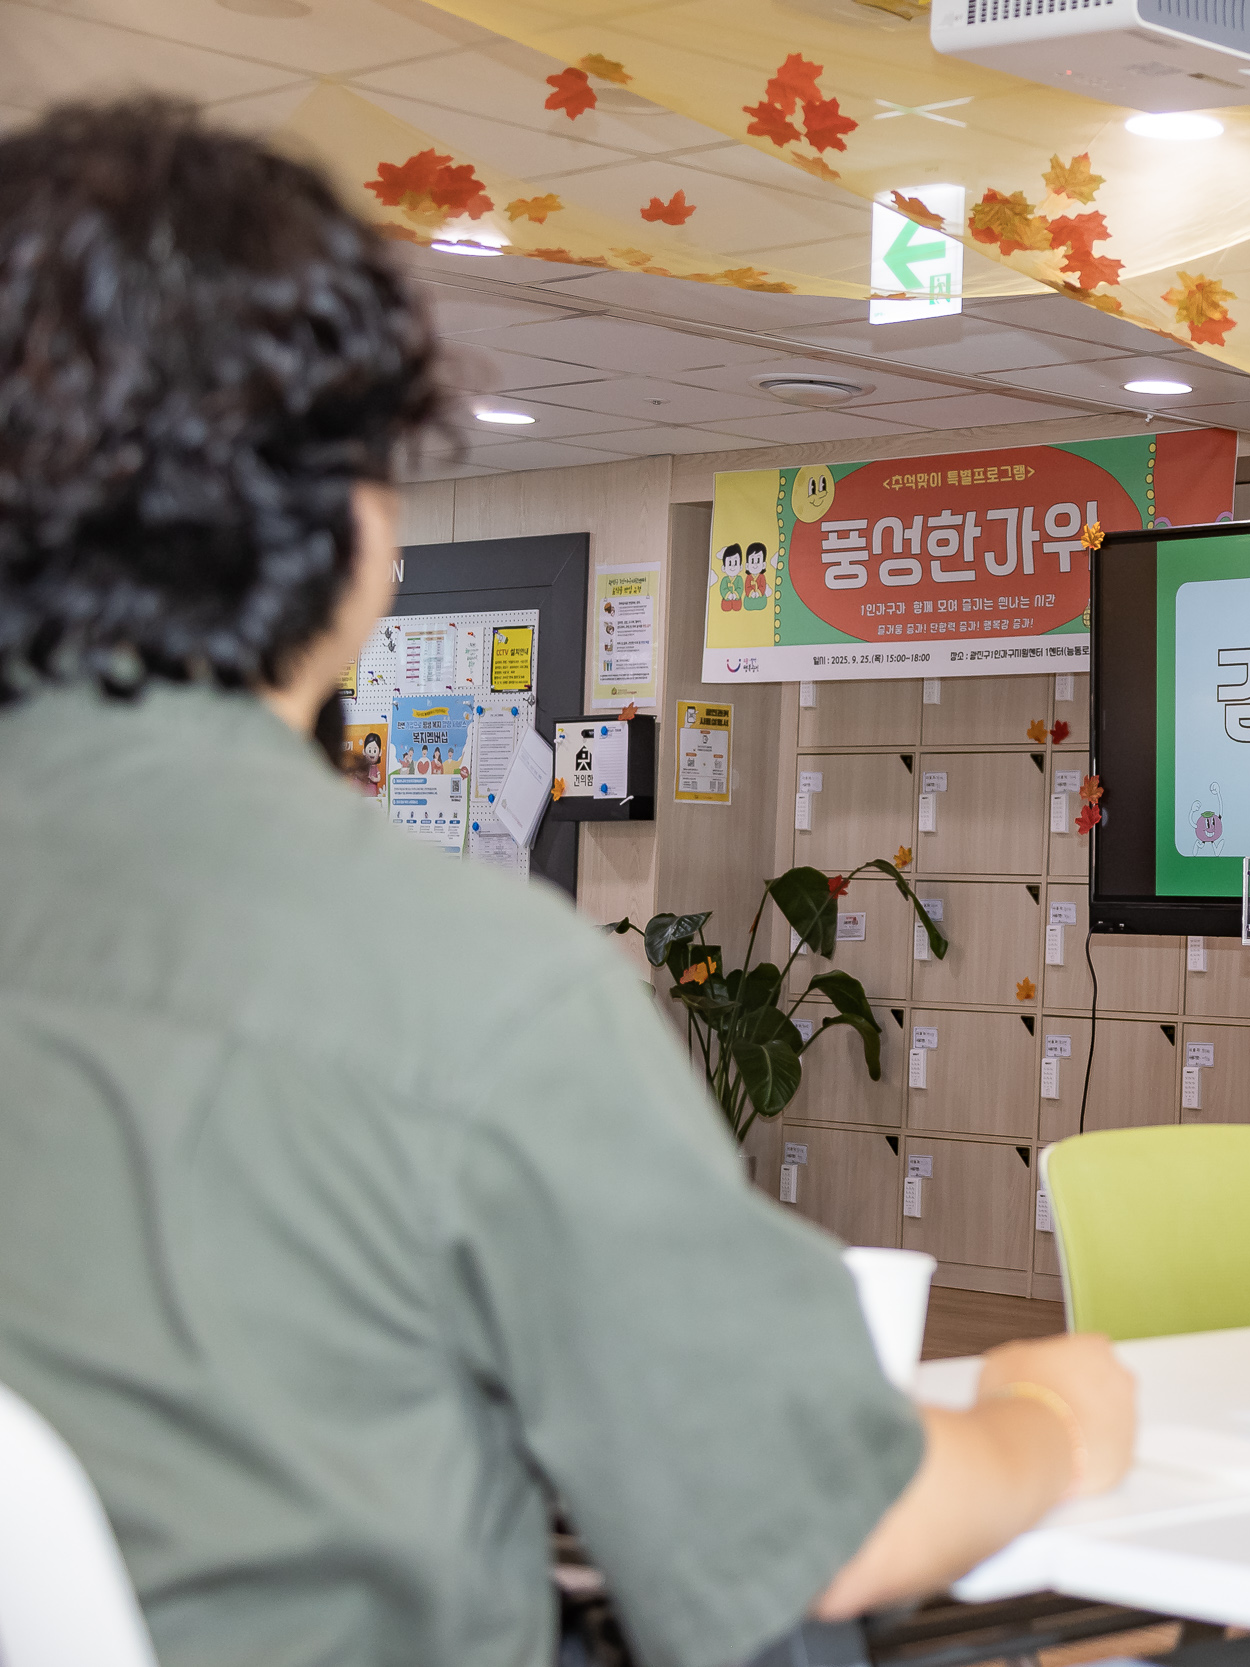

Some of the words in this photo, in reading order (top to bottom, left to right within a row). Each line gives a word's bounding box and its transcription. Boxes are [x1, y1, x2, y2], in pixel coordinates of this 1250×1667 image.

[883, 472, 942, 491] <추석맞이
[947, 464, 1036, 486] 특별프로그램>
[821, 500, 1098, 590] 풍성한가위
[861, 602, 907, 617] 1인가구가
[913, 601, 933, 615] 함께
[937, 599, 958, 613] 모여
[962, 598, 994, 612] 즐기는
[1034, 594, 1056, 607] 시간
[877, 624, 903, 636] 즐거움
[906, 623, 927, 635] 증가!
[930, 621, 956, 634] 단합력
[959, 620, 980, 632] 증가!
[983, 619, 1009, 631] 행복감
[1013, 618, 1034, 630] 증가!
[496, 648, 508, 656] CCTV
[950, 651, 964, 661] 장소
[831, 655, 850, 665] 2025.
[852, 655, 859, 664] 9.
[412, 731, 448, 744] 복지멤버십
[574, 774, 593, 787] 건의함
